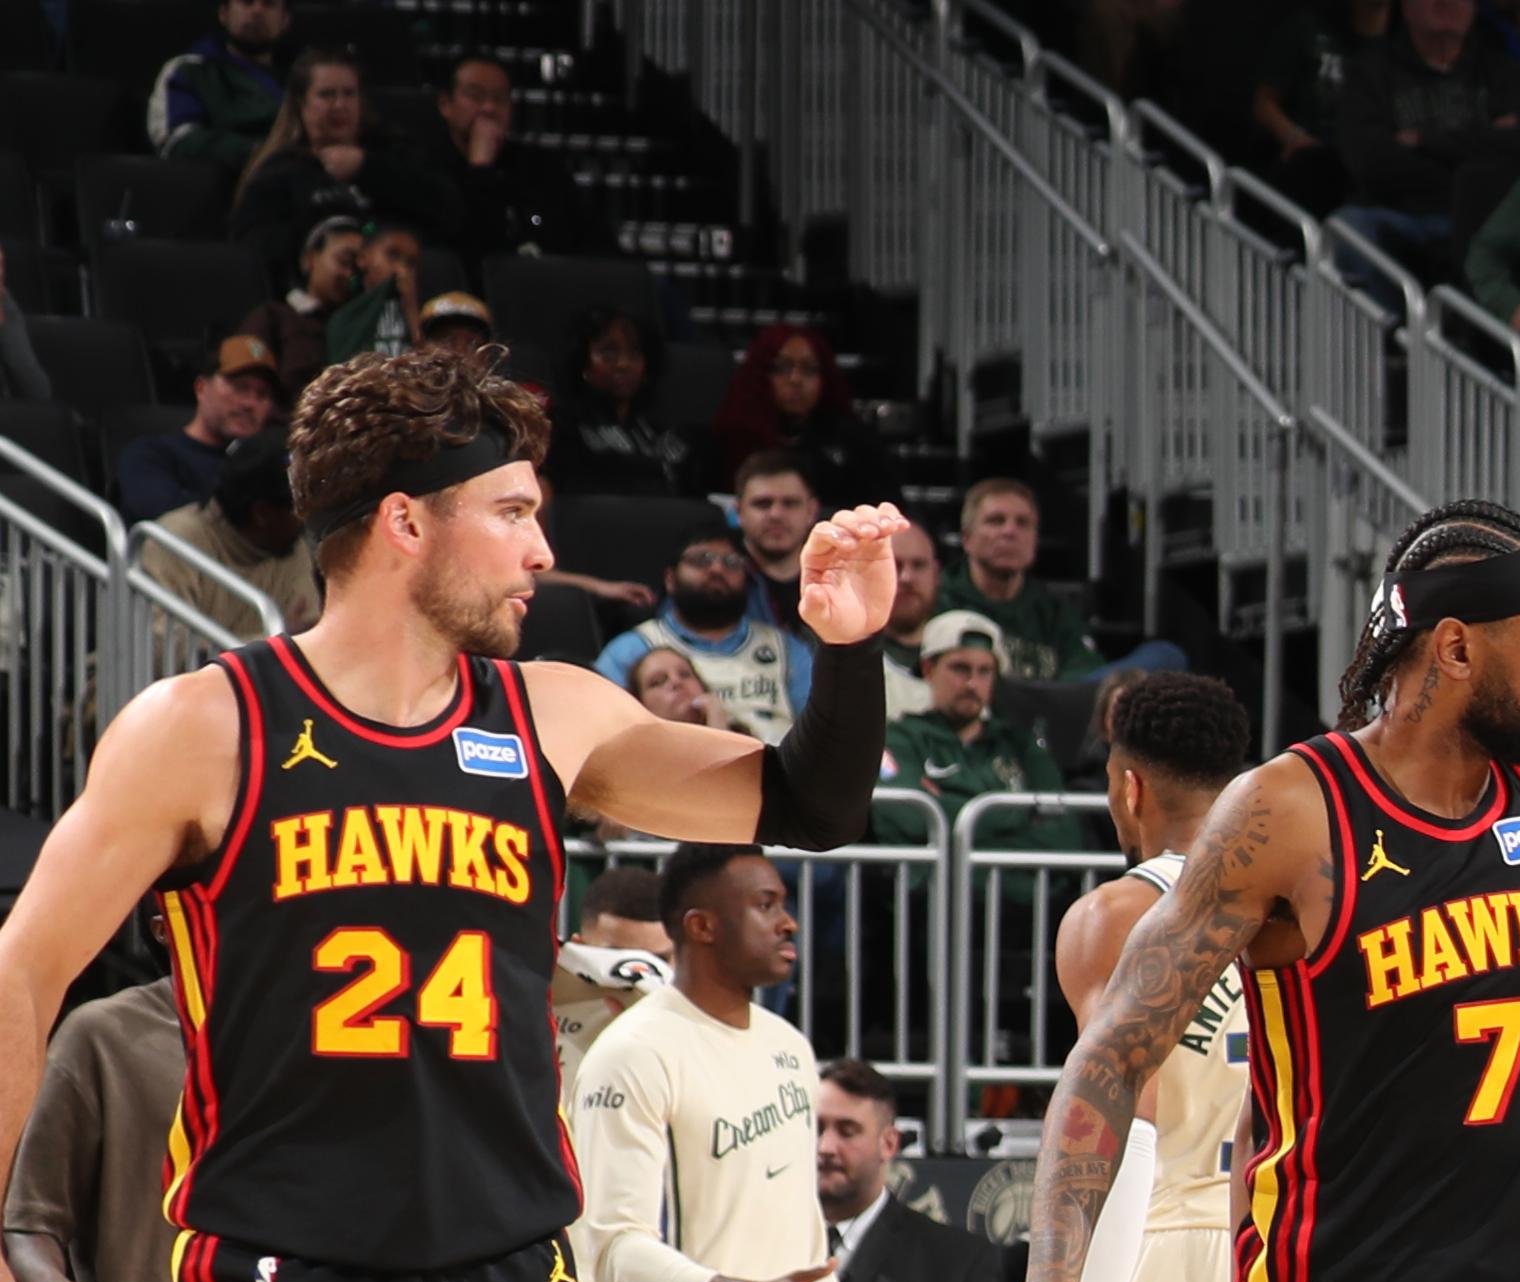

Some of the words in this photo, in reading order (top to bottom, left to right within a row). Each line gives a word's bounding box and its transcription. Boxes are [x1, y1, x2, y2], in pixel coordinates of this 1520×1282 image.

[462, 739, 517, 763] paze
[271, 804, 532, 905] HAWKS
[311, 926, 498, 1061] 24
[773, 1051, 799, 1071] wilo
[584, 1085, 625, 1109] wilo
[712, 1100, 784, 1160] Cream
[778, 1079, 812, 1129] City
